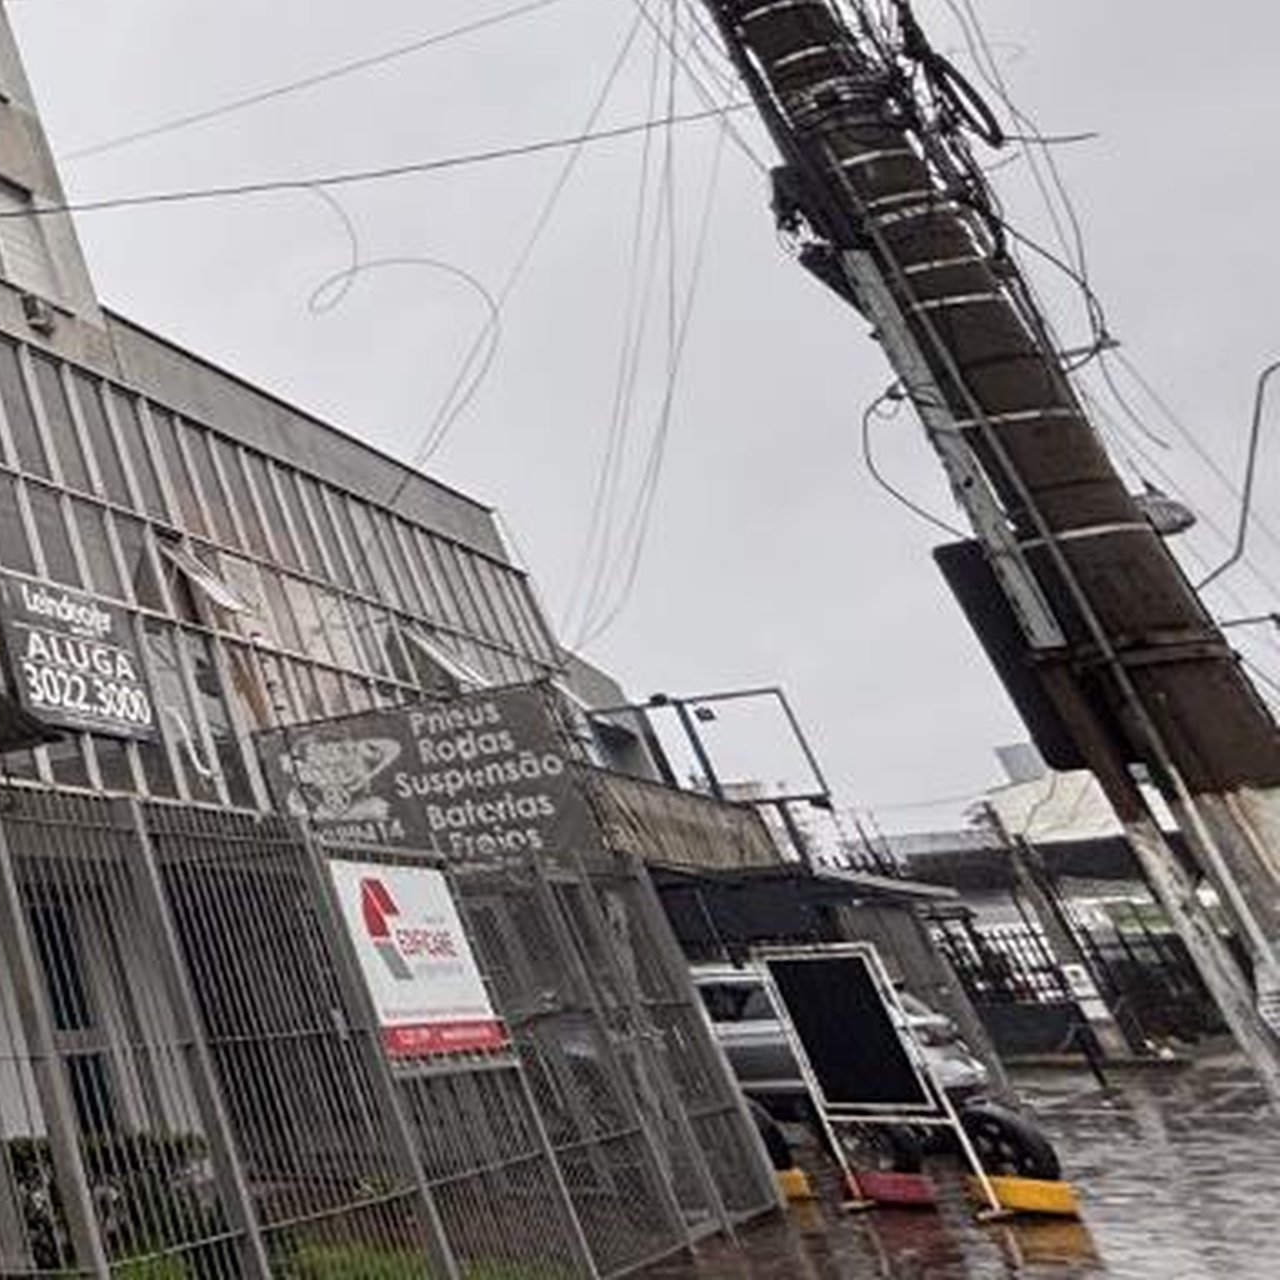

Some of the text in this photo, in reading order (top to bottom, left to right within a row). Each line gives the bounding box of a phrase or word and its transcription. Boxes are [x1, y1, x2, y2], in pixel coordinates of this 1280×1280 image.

[26, 631, 138, 682] ALUGA
[409, 702, 502, 736] Pneus
[417, 729, 515, 765] Rodas
[393, 751, 564, 798] Suspensão
[426, 791, 556, 831] Baterias
[448, 824, 544, 860] Freios
